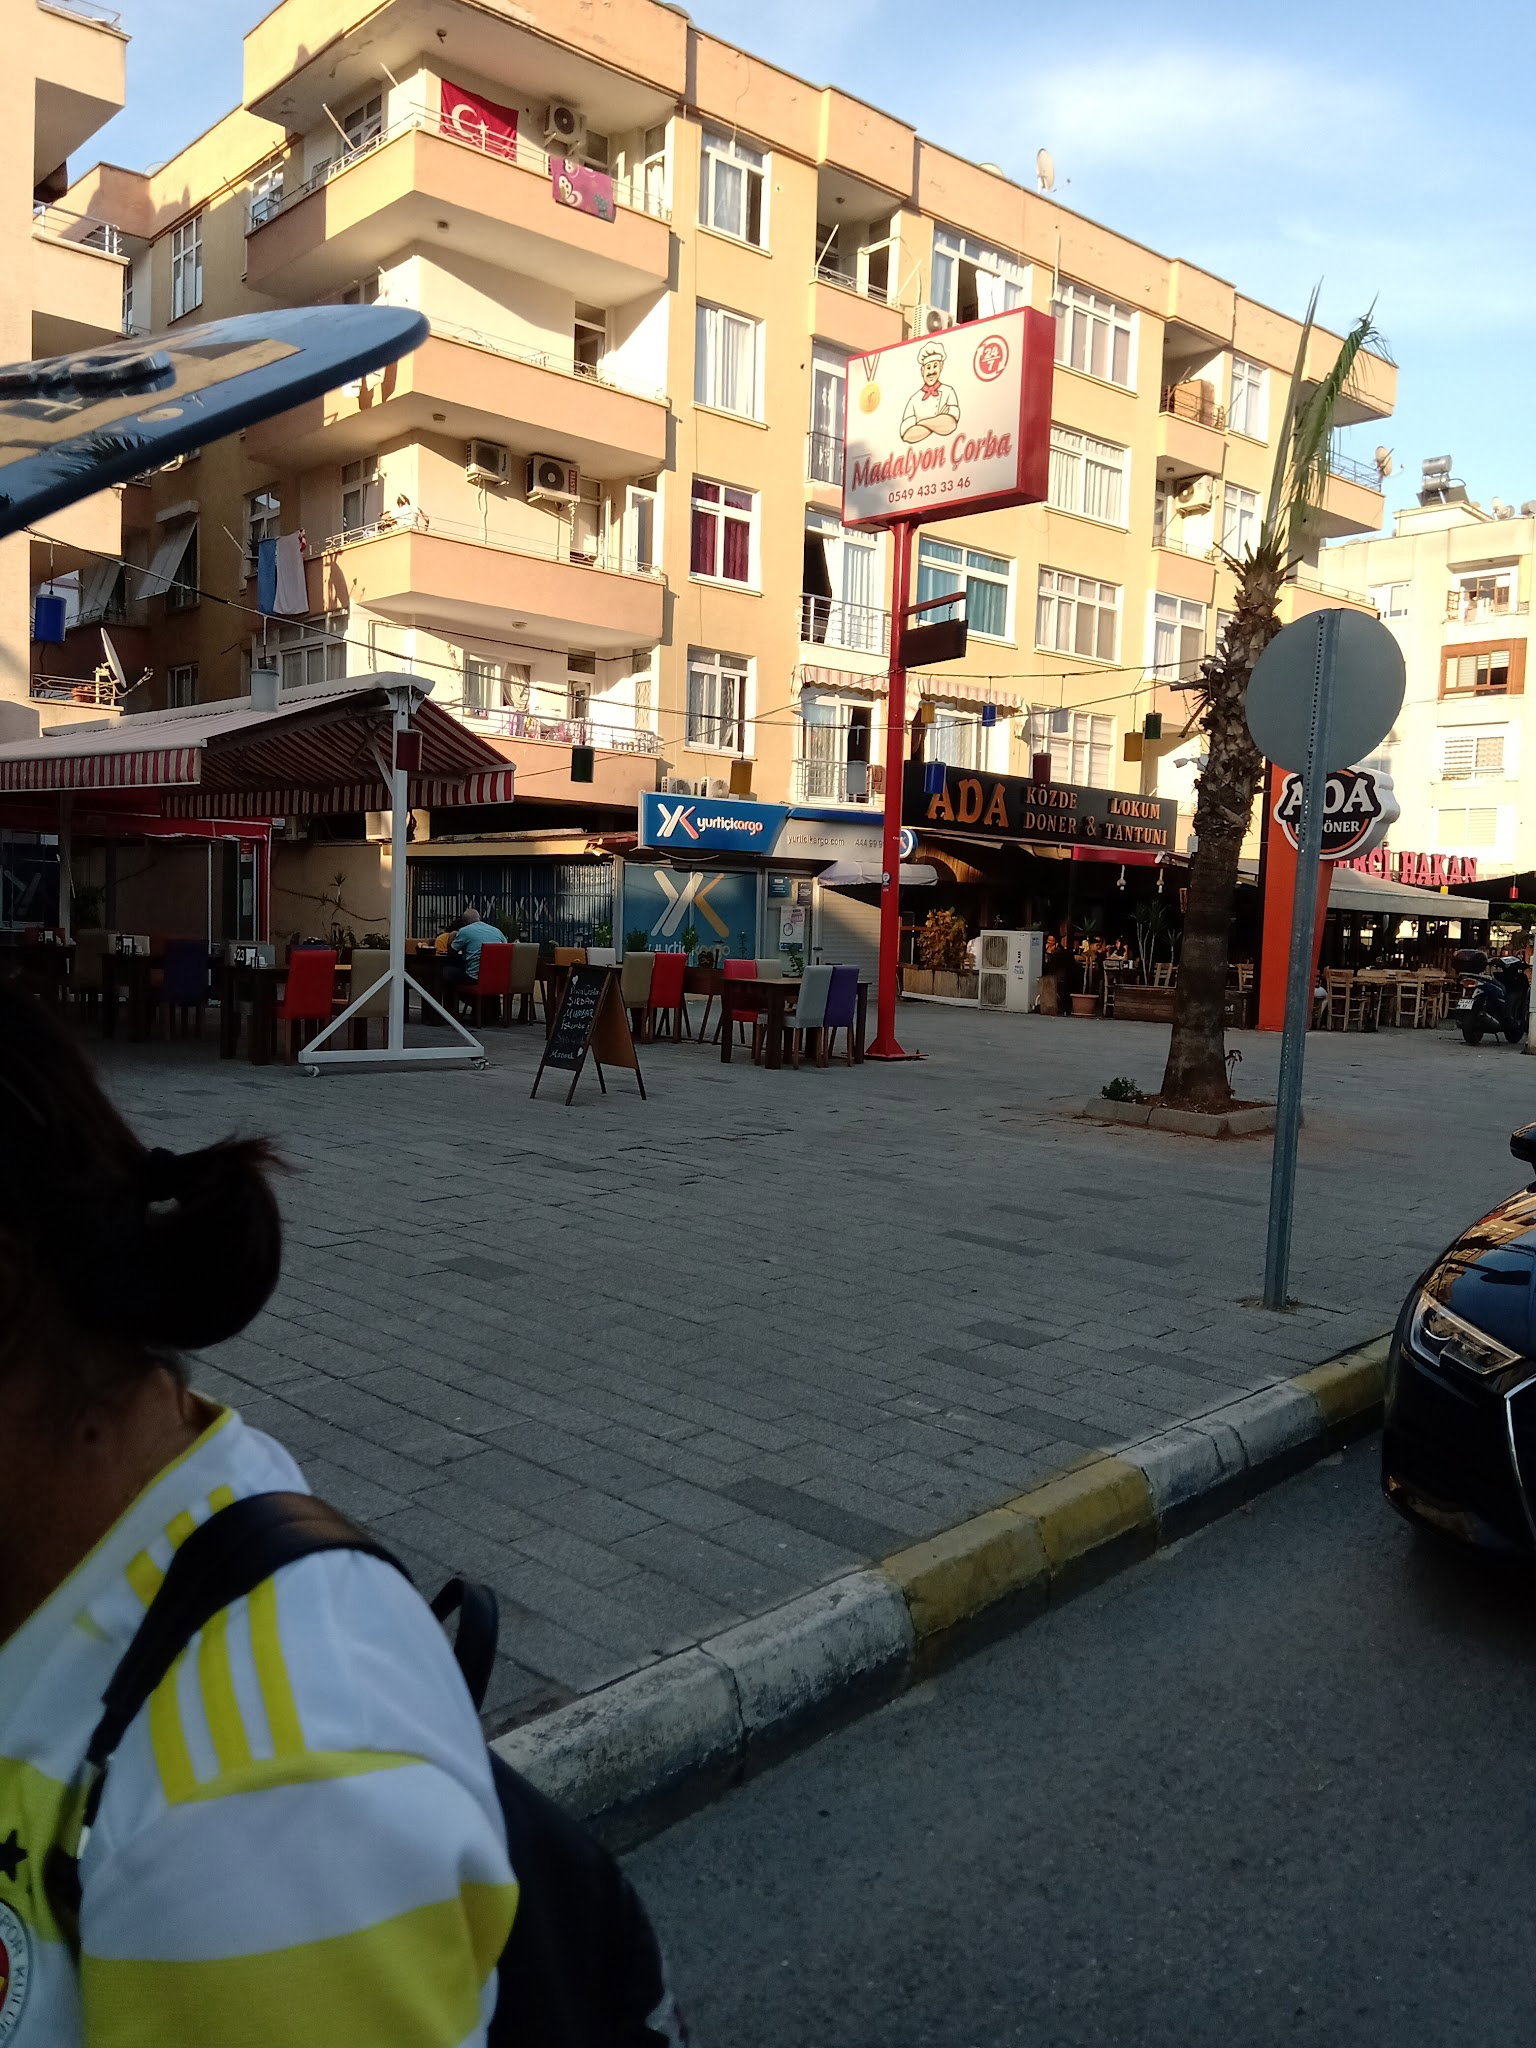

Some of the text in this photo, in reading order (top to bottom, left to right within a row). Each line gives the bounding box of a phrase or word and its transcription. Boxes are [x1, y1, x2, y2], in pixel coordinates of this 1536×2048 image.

[852, 430, 1011, 491] Madalyon Çorba
[888, 476, 971, 504] 0549 433 33 46
[926, 778, 1009, 828] ADA
[1025, 783, 1078, 810] KÖZDE
[1111, 797, 1160, 820] LOKUM
[1283, 777, 1375, 816] ADA
[697, 816, 763, 836] yurtiçikargo
[1086, 815, 1097, 838] &
[1105, 823, 1167, 846] TANTUNI
[1321, 820, 1360, 833] ÖNER
[1400, 851, 1477, 886] HAKAN
